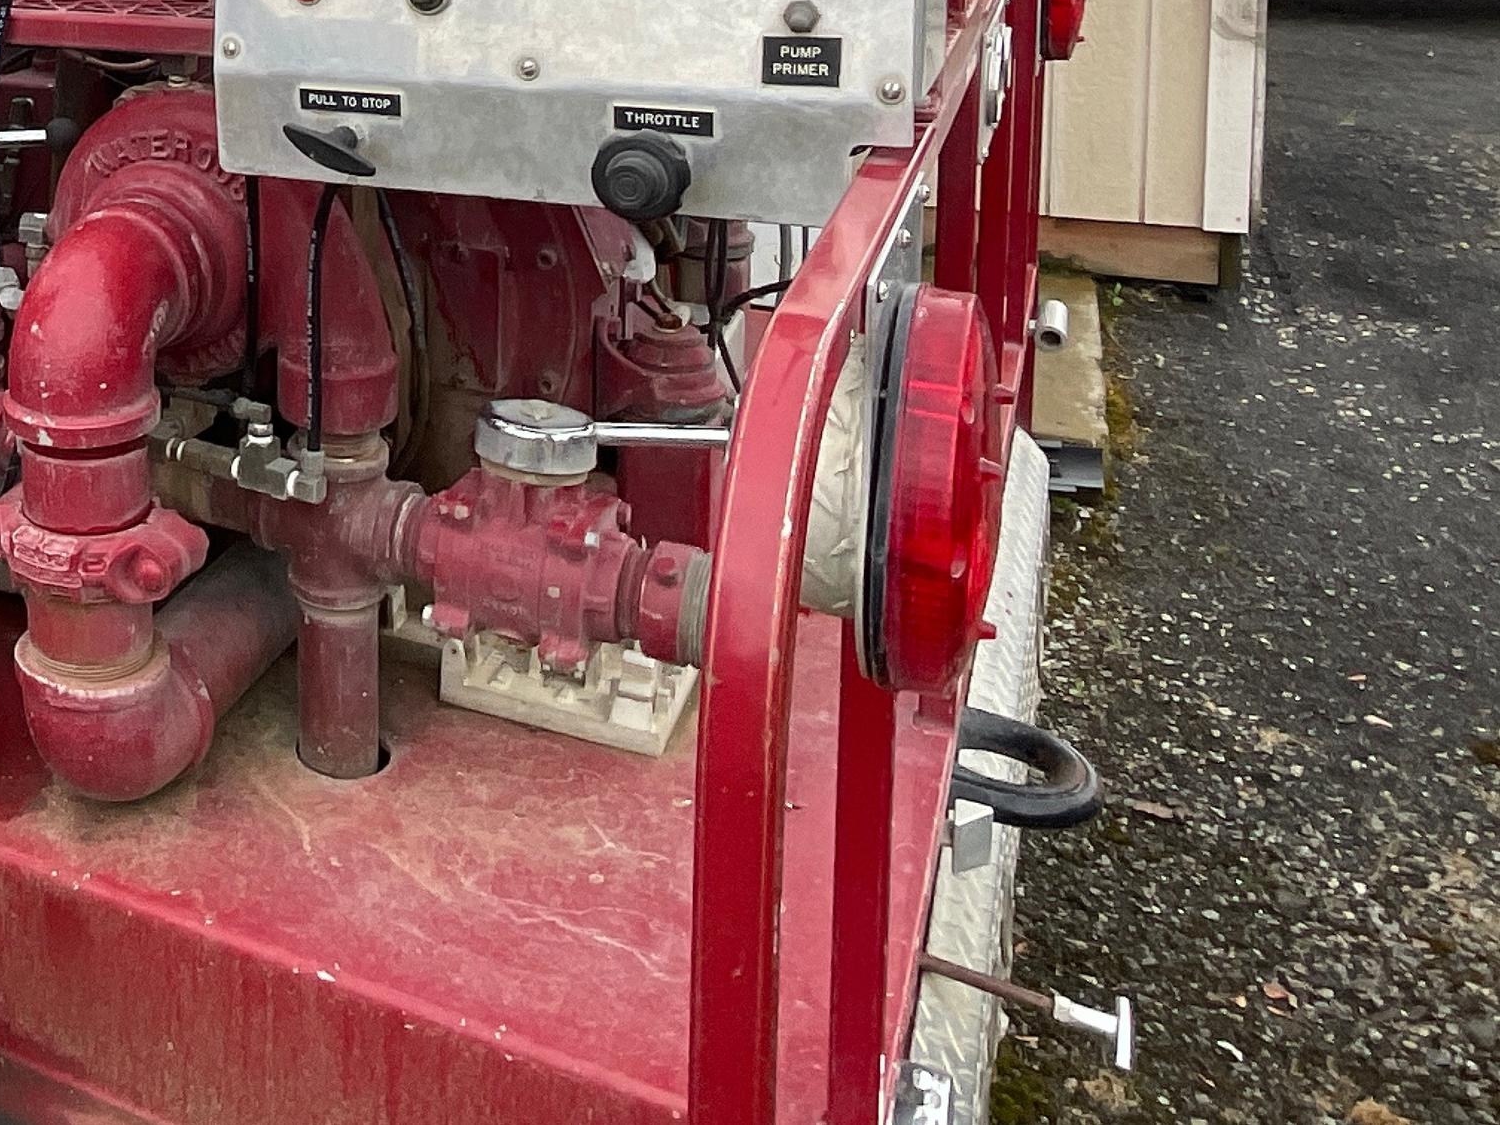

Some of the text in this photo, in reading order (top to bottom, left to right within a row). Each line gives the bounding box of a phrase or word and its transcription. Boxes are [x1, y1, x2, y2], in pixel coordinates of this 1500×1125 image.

[780, 45, 822, 58] PUMP
[772, 62, 829, 77] PRIMER
[308, 93, 391, 110] PULL TO STOP
[624, 110, 701, 128] THROTTLE
